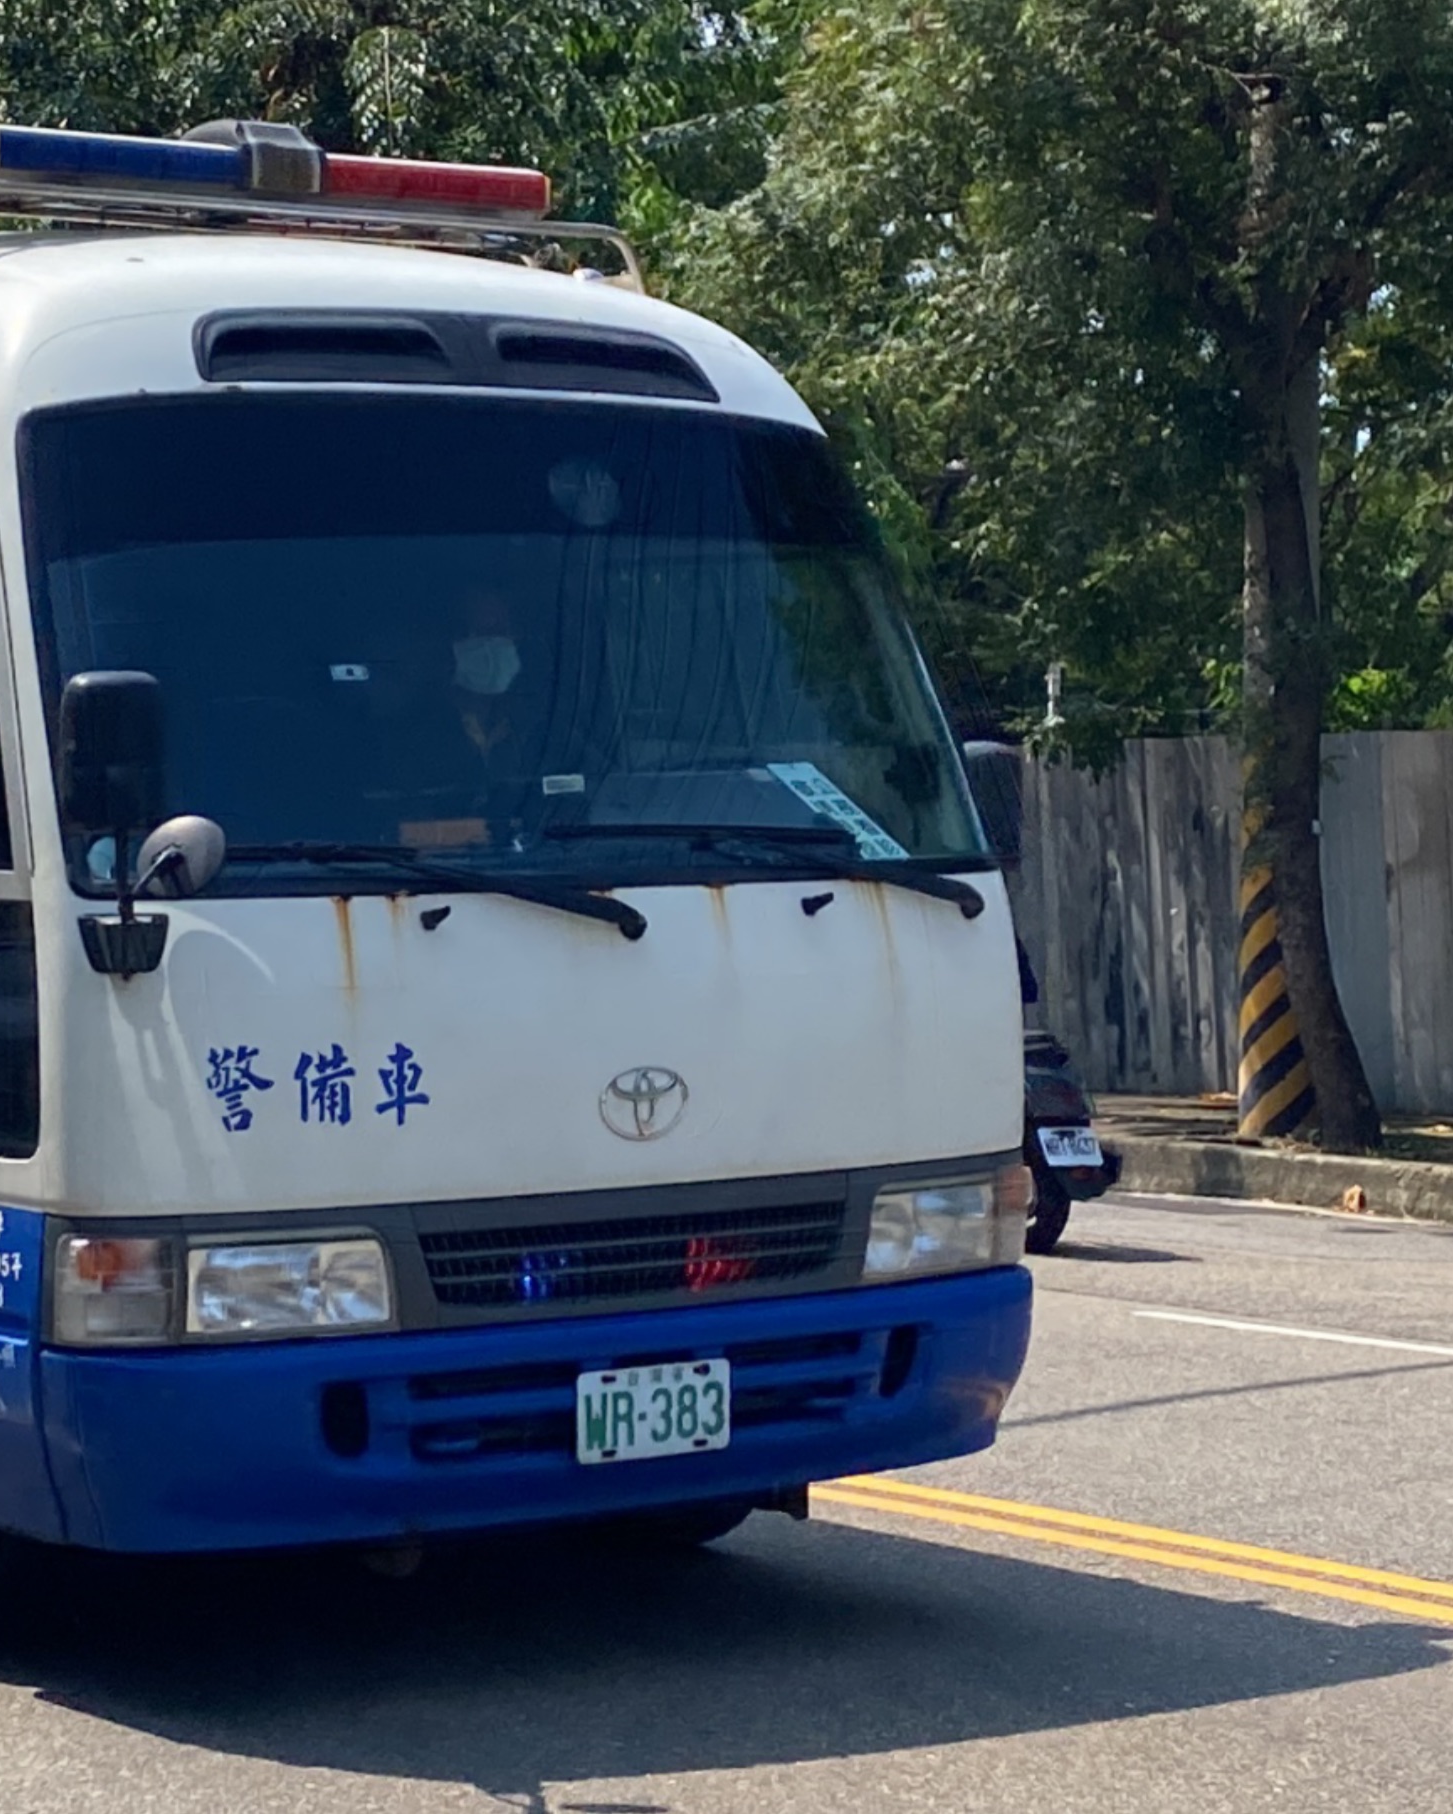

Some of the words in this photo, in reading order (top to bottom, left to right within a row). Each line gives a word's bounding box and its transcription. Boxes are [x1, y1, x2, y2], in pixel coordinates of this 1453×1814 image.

[206, 1042, 431, 1132] 警備車
[584, 1380, 726, 1451] WR-383
